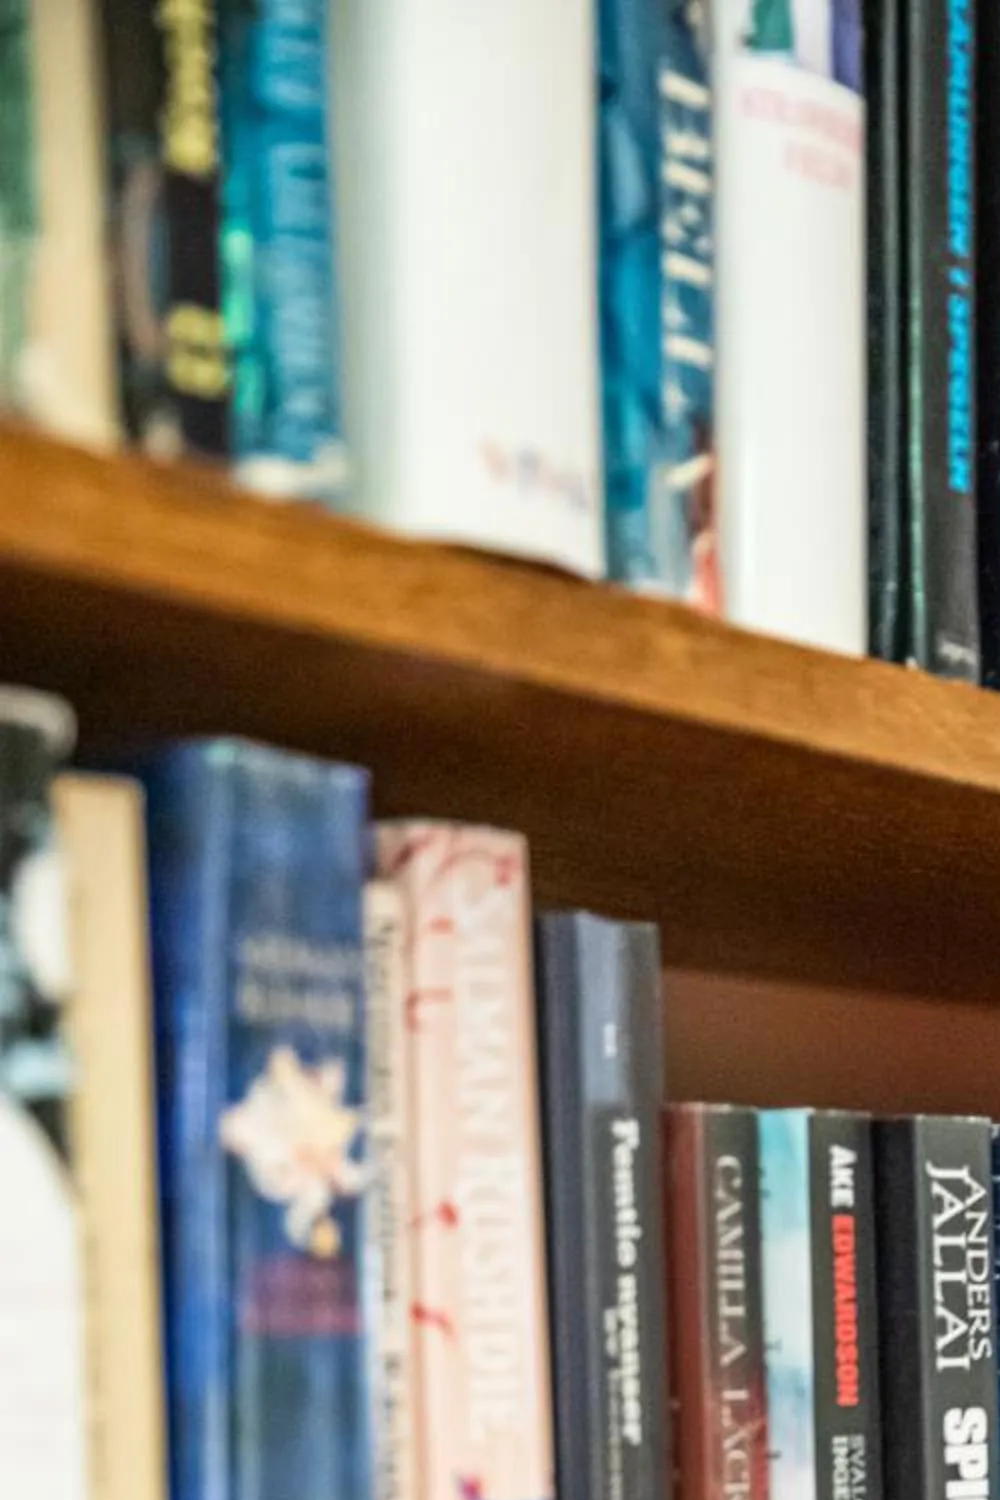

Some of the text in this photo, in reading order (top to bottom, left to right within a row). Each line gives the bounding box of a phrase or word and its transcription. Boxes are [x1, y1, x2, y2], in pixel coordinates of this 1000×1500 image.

[611, 1118, 643, 1445] Femtio nyanser
[715, 1154, 747, 1368] CAMILLA
[830, 1213, 860, 1408] EDWARDSON
[924, 1160, 973, 1374] JALLAI
[963, 1170, 994, 1363] ANDERS
